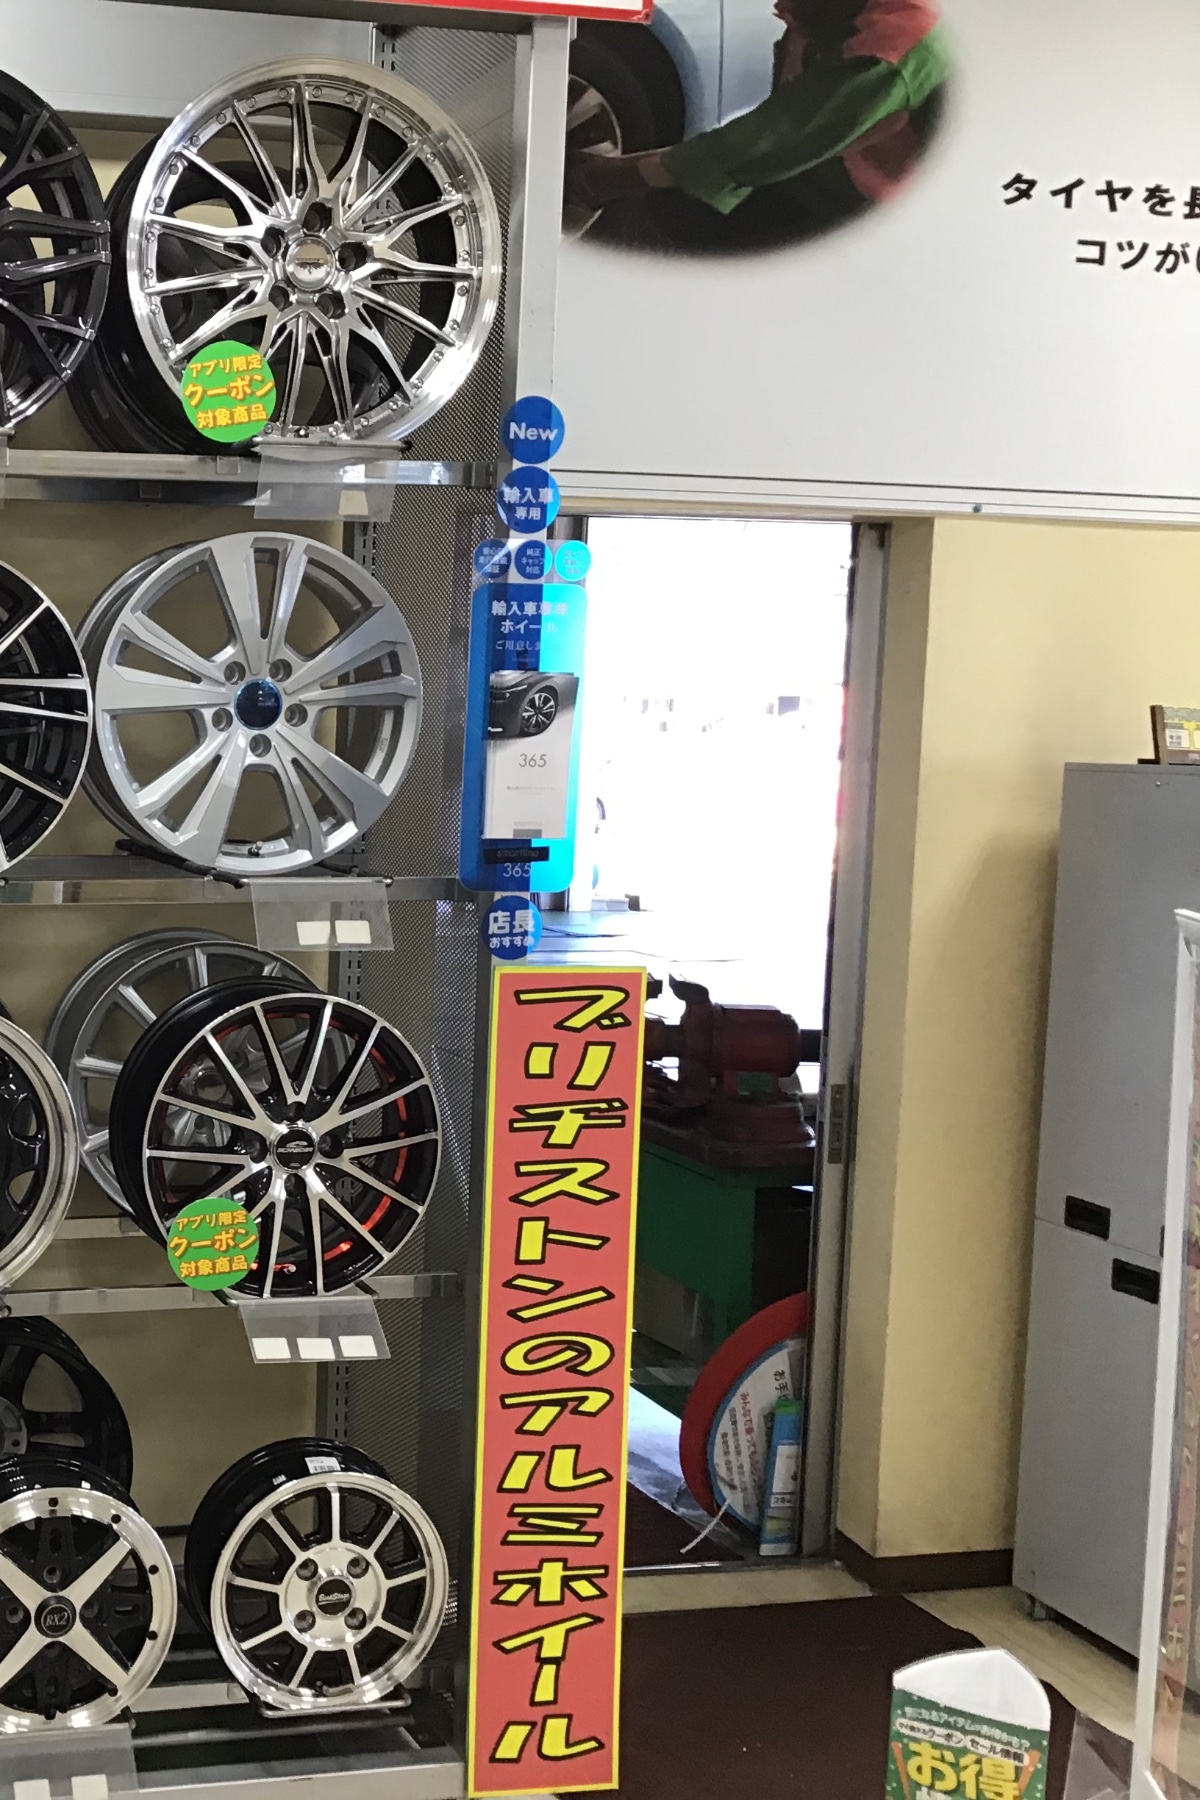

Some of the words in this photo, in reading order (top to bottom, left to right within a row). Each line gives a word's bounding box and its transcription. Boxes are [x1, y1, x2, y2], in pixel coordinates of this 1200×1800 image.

[189, 353, 262, 378] アプリ限定
[184, 374, 274, 407] クーポン
[196, 403, 267, 429] 対象商品
[509, 421, 558, 441] New
[503, 487, 554, 504] 輸入車
[515, 506, 541, 520] 専用
[491, 600, 569, 617] 輸入車専用
[500, 620, 556, 634] ホイール
[518, 753, 547, 768] 365
[502, 862, 532, 878] 365
[488, 910, 535, 935] 店長
[488, 935, 535, 949] おすすめ
[176, 1210, 247, 1231] アプリ限定
[169, 1228, 257, 1258] クーポン
[179, 1254, 248, 1278] 対象商品
[906, 1741, 1020, 1800] お得
